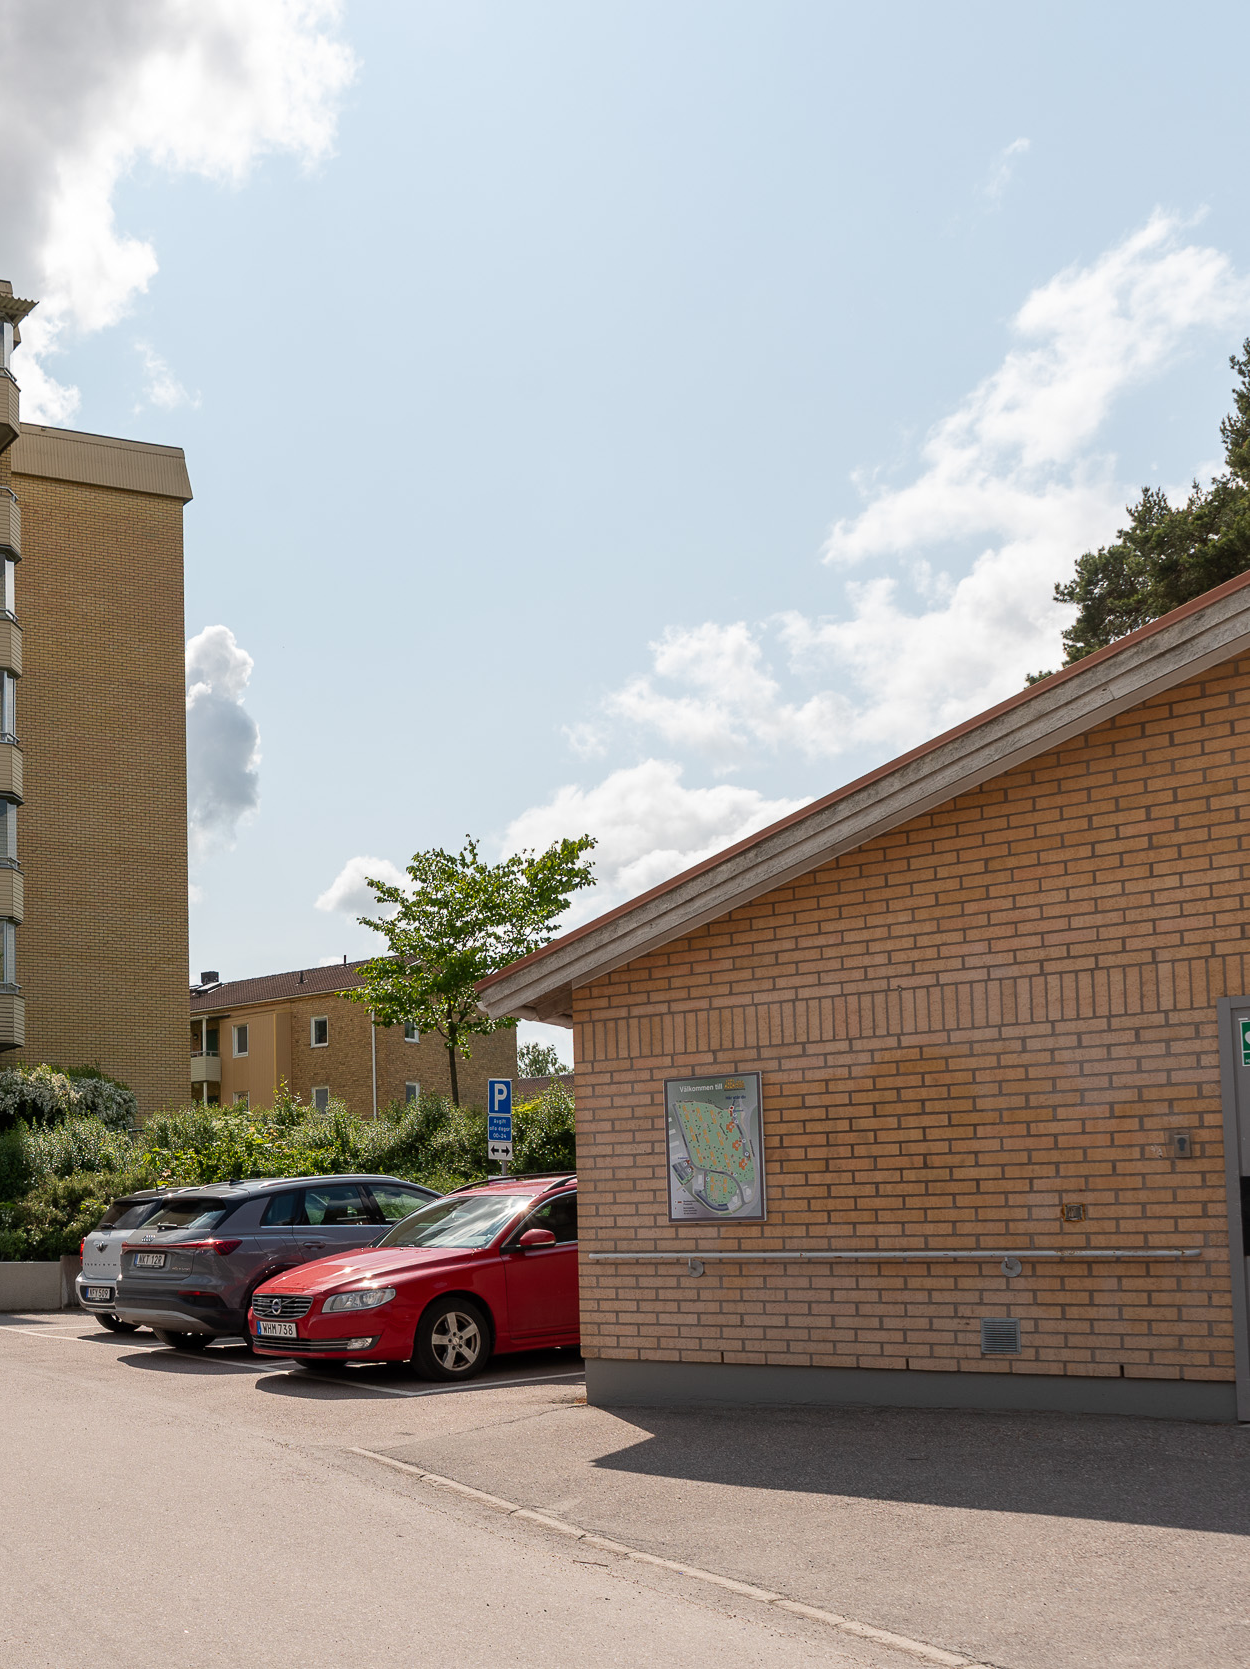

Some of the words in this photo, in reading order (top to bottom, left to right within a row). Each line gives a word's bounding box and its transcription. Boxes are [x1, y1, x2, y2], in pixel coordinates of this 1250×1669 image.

[679, 1084, 714, 1093] Välkommen
[715, 1082, 723, 1090] till
[494, 1083, 508, 1111] P
[262, 1322, 277, 1335] WHM
[277, 1323, 294, 1336] 738
